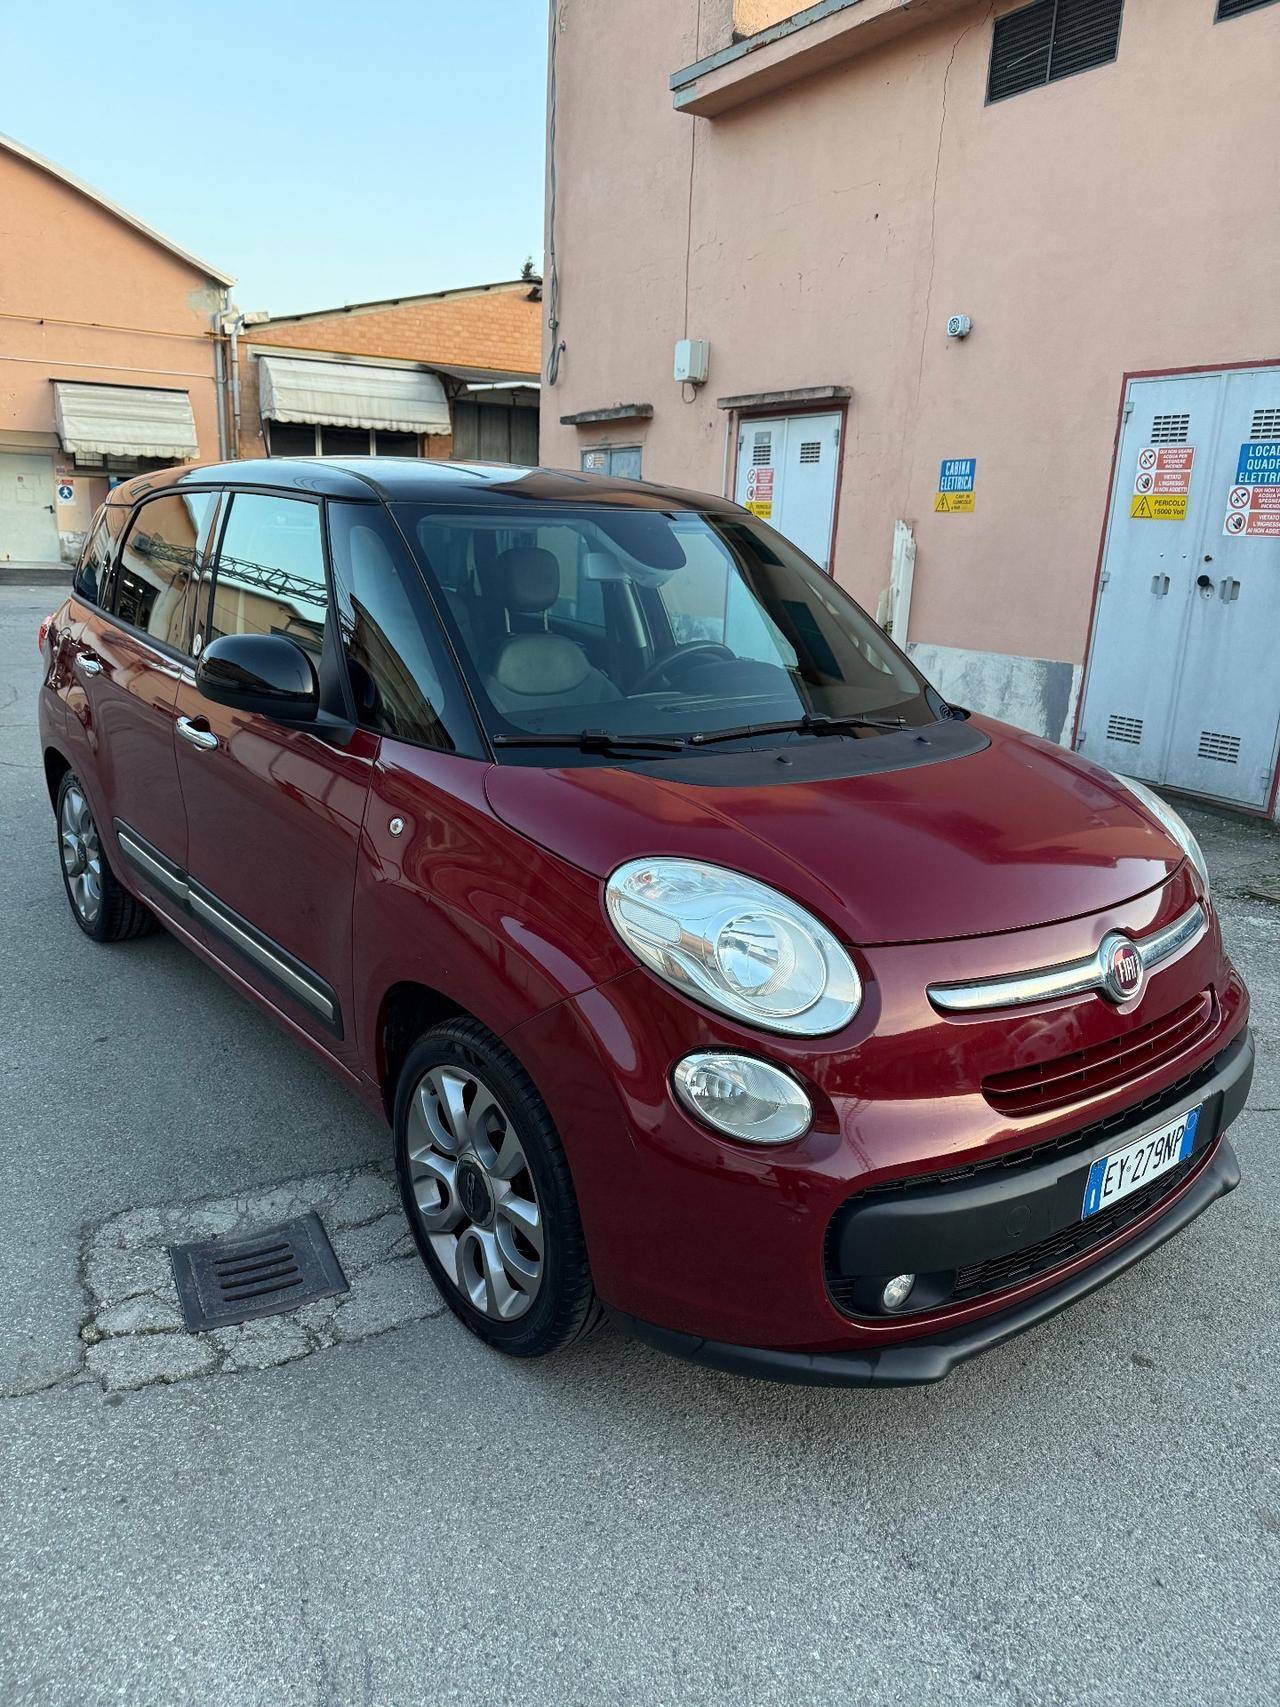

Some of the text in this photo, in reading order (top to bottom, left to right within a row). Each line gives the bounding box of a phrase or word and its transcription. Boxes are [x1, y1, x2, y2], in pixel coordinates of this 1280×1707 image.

[945, 461, 970, 476] CABINA
[940, 476, 972, 490] ELETTRICA
[1154, 499, 1186, 507] PERICOLO
[1118, 954, 1138, 983] FIAT
